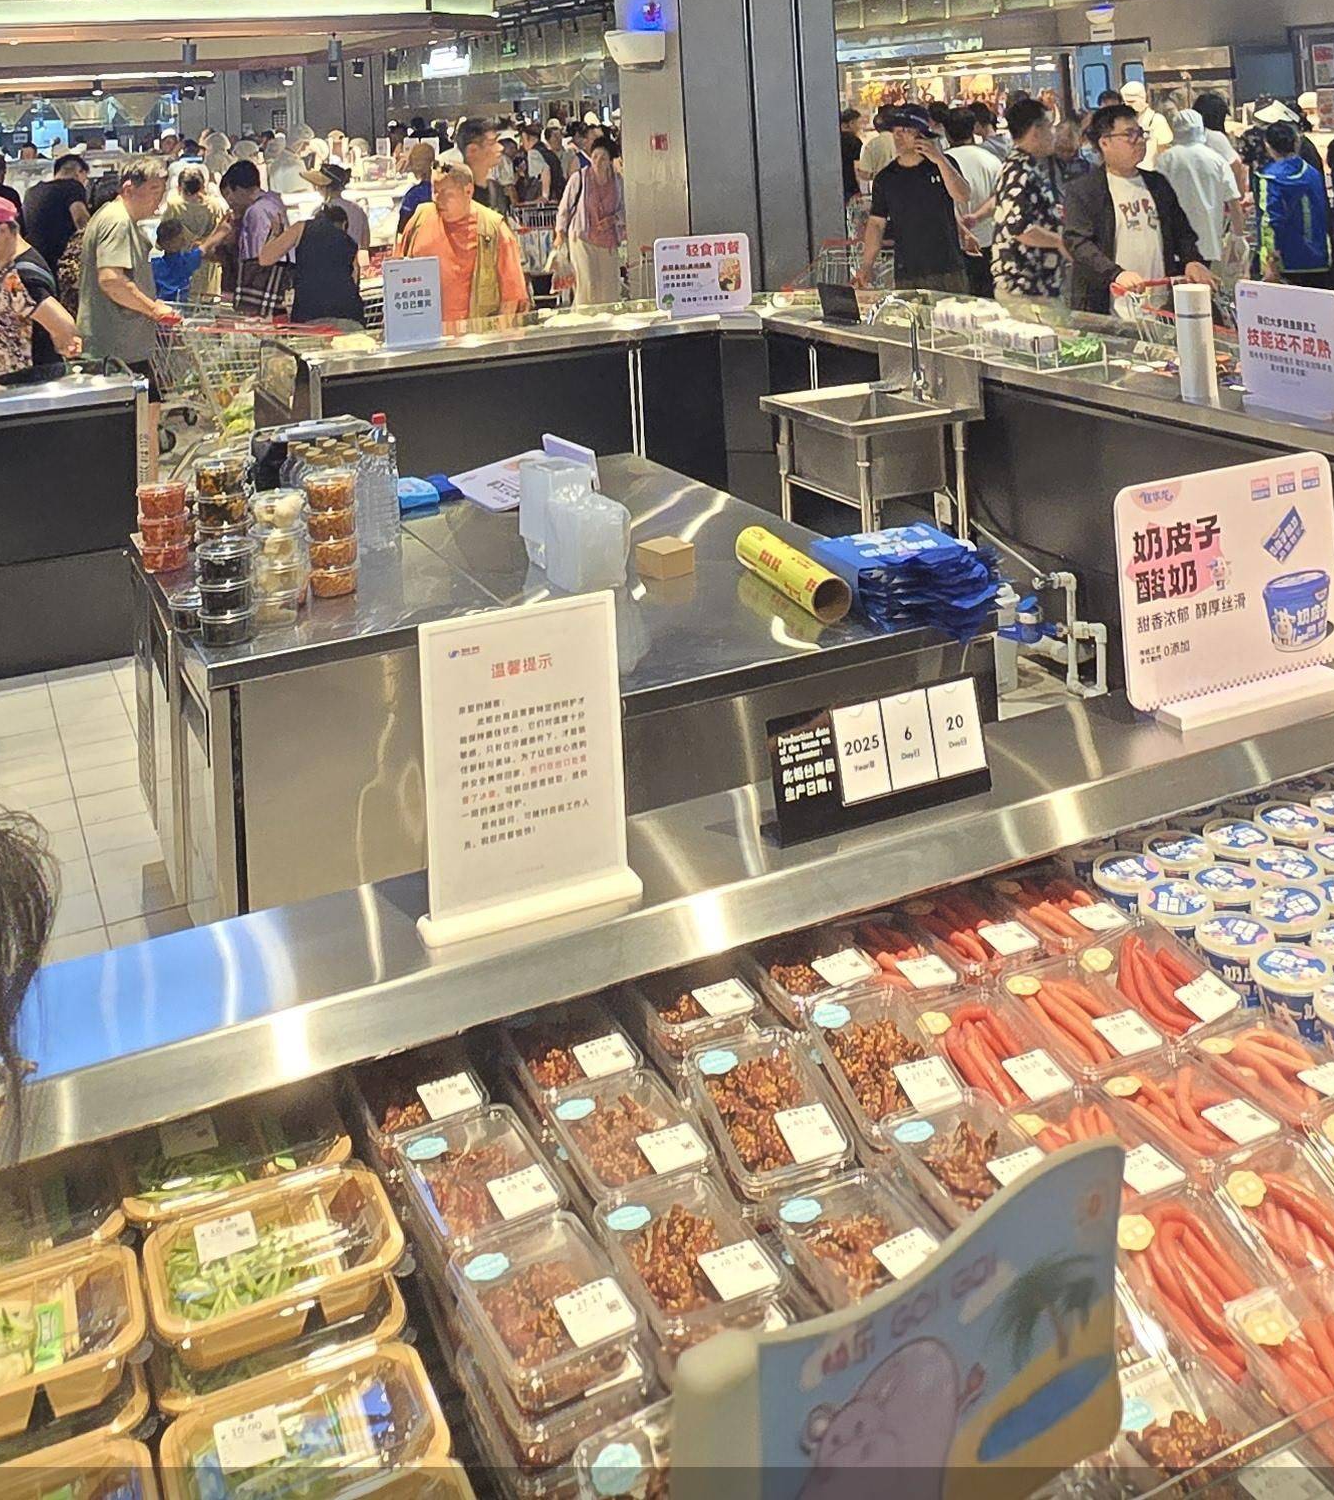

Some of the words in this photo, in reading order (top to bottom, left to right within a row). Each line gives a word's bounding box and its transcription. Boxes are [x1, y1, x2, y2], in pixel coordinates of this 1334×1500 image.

[685, 240, 739, 256] 轻食简餐
[1246, 327, 1332, 359] 技能还不成熟
[1132, 514, 1221, 564] 奶皮子
[1135, 560, 1198, 605] 酸奶
[1137, 606, 1190, 634] 甜香浓郁
[1195, 592, 1246, 620] 醇厚丝滑
[491, 653, 553, 679] 温馨提示
[904, 726, 913, 741] 6
[946, 714, 964, 731] 20
[844, 734, 880, 756] 2025
